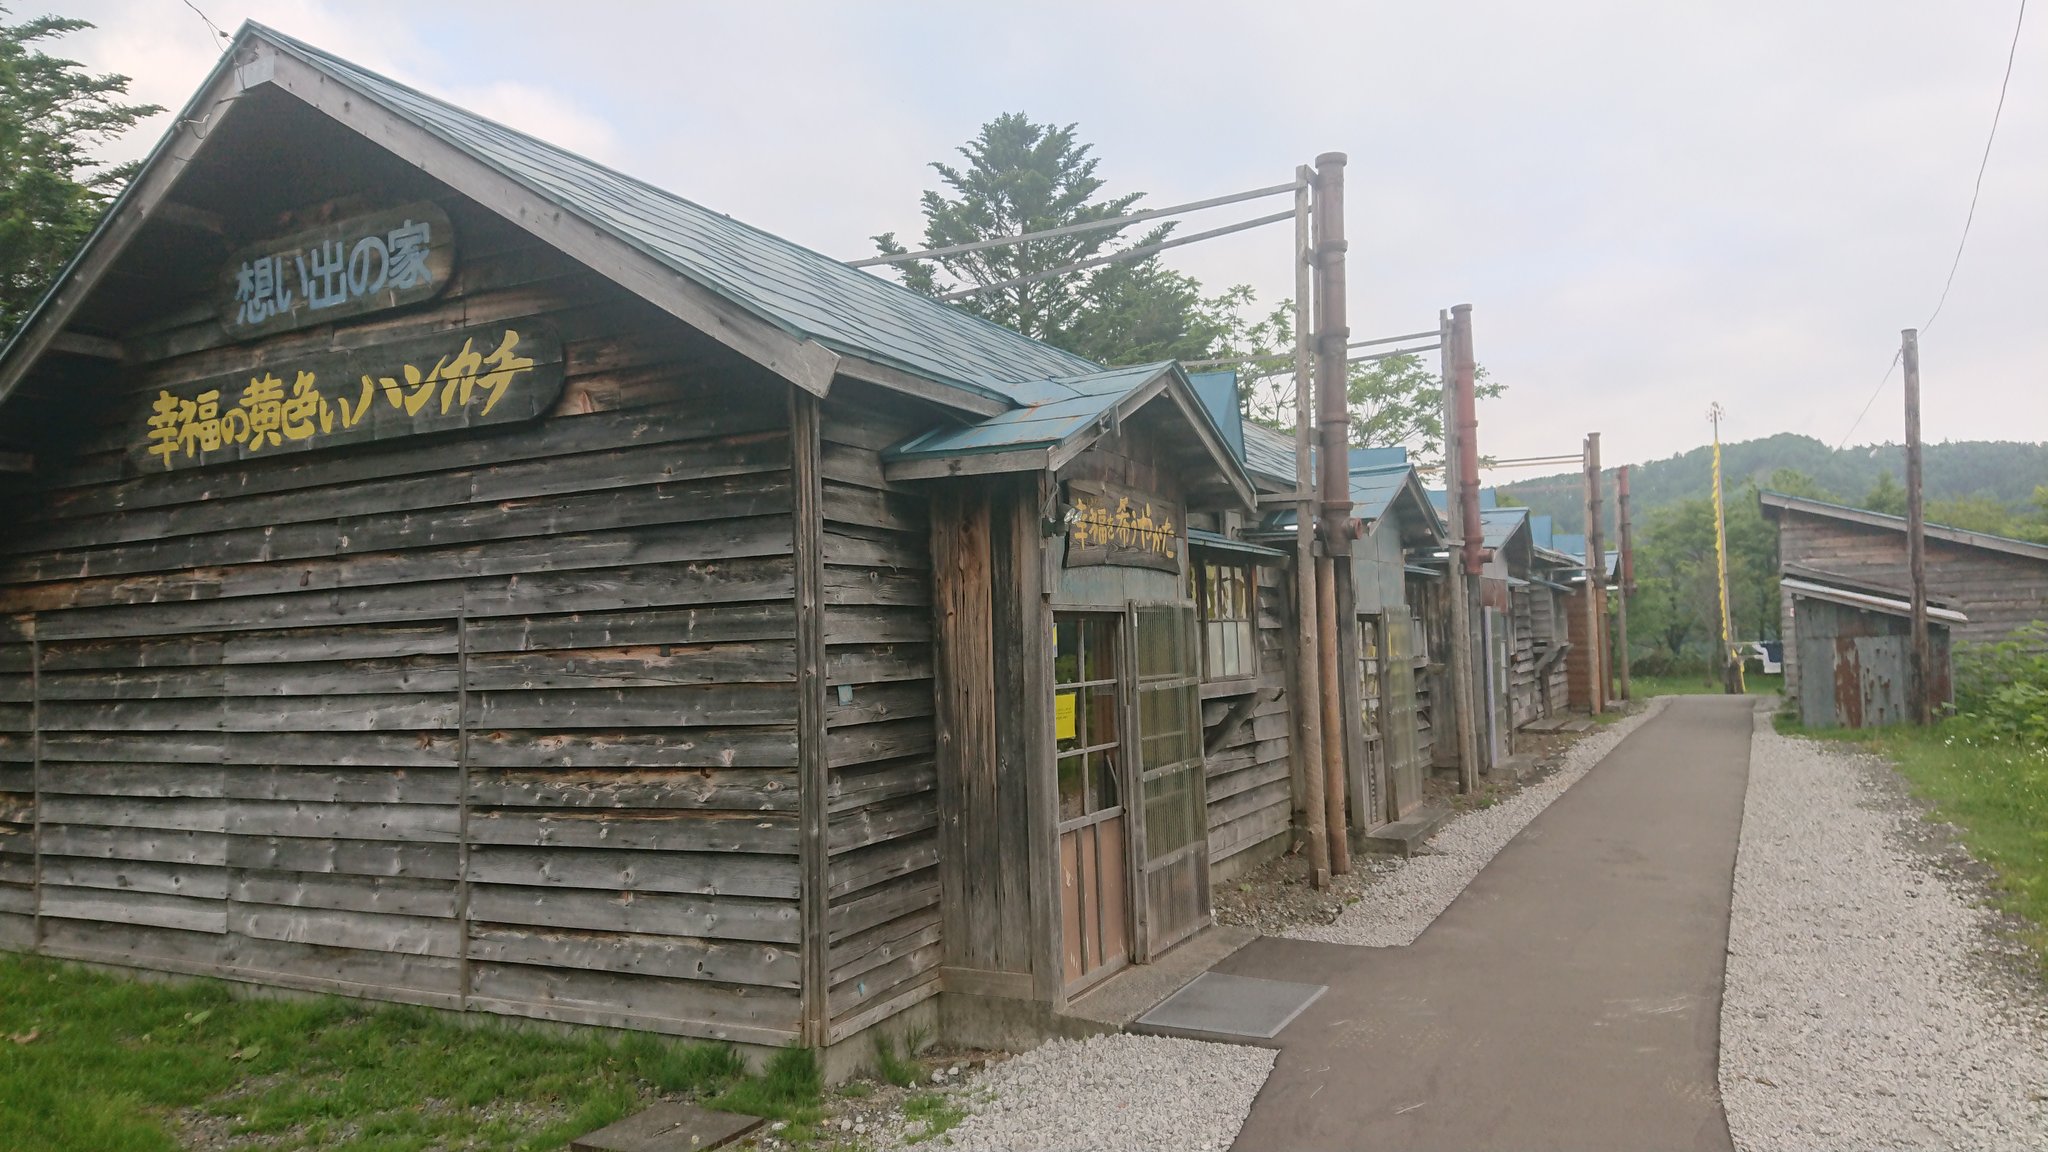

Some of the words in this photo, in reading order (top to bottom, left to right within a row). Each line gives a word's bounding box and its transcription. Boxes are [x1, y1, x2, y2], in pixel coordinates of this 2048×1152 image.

[234, 219, 432, 325] 想い出の家
[147, 329, 534, 471] 幸福の黄色いハンカチ
